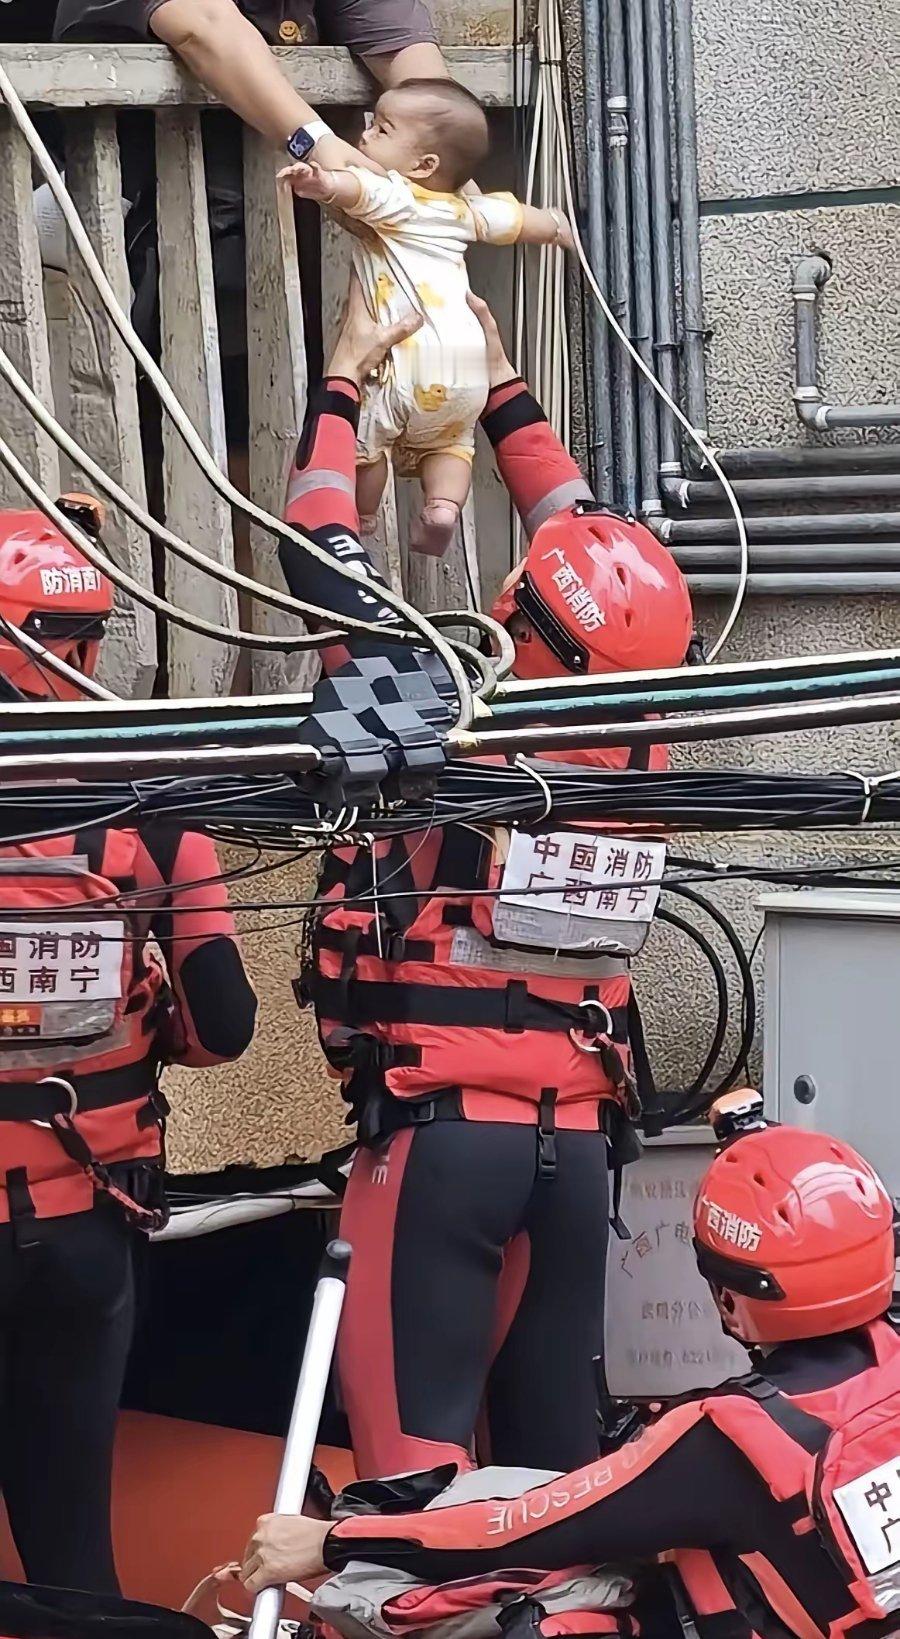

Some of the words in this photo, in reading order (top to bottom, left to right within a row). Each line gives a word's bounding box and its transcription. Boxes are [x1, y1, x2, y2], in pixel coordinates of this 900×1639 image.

[541, 548, 606, 633] 广西消防
[534, 837, 653, 878] 中国消防
[527, 871, 647, 913] 广西南宁
[486, 1466, 613, 1535] RESCUE
